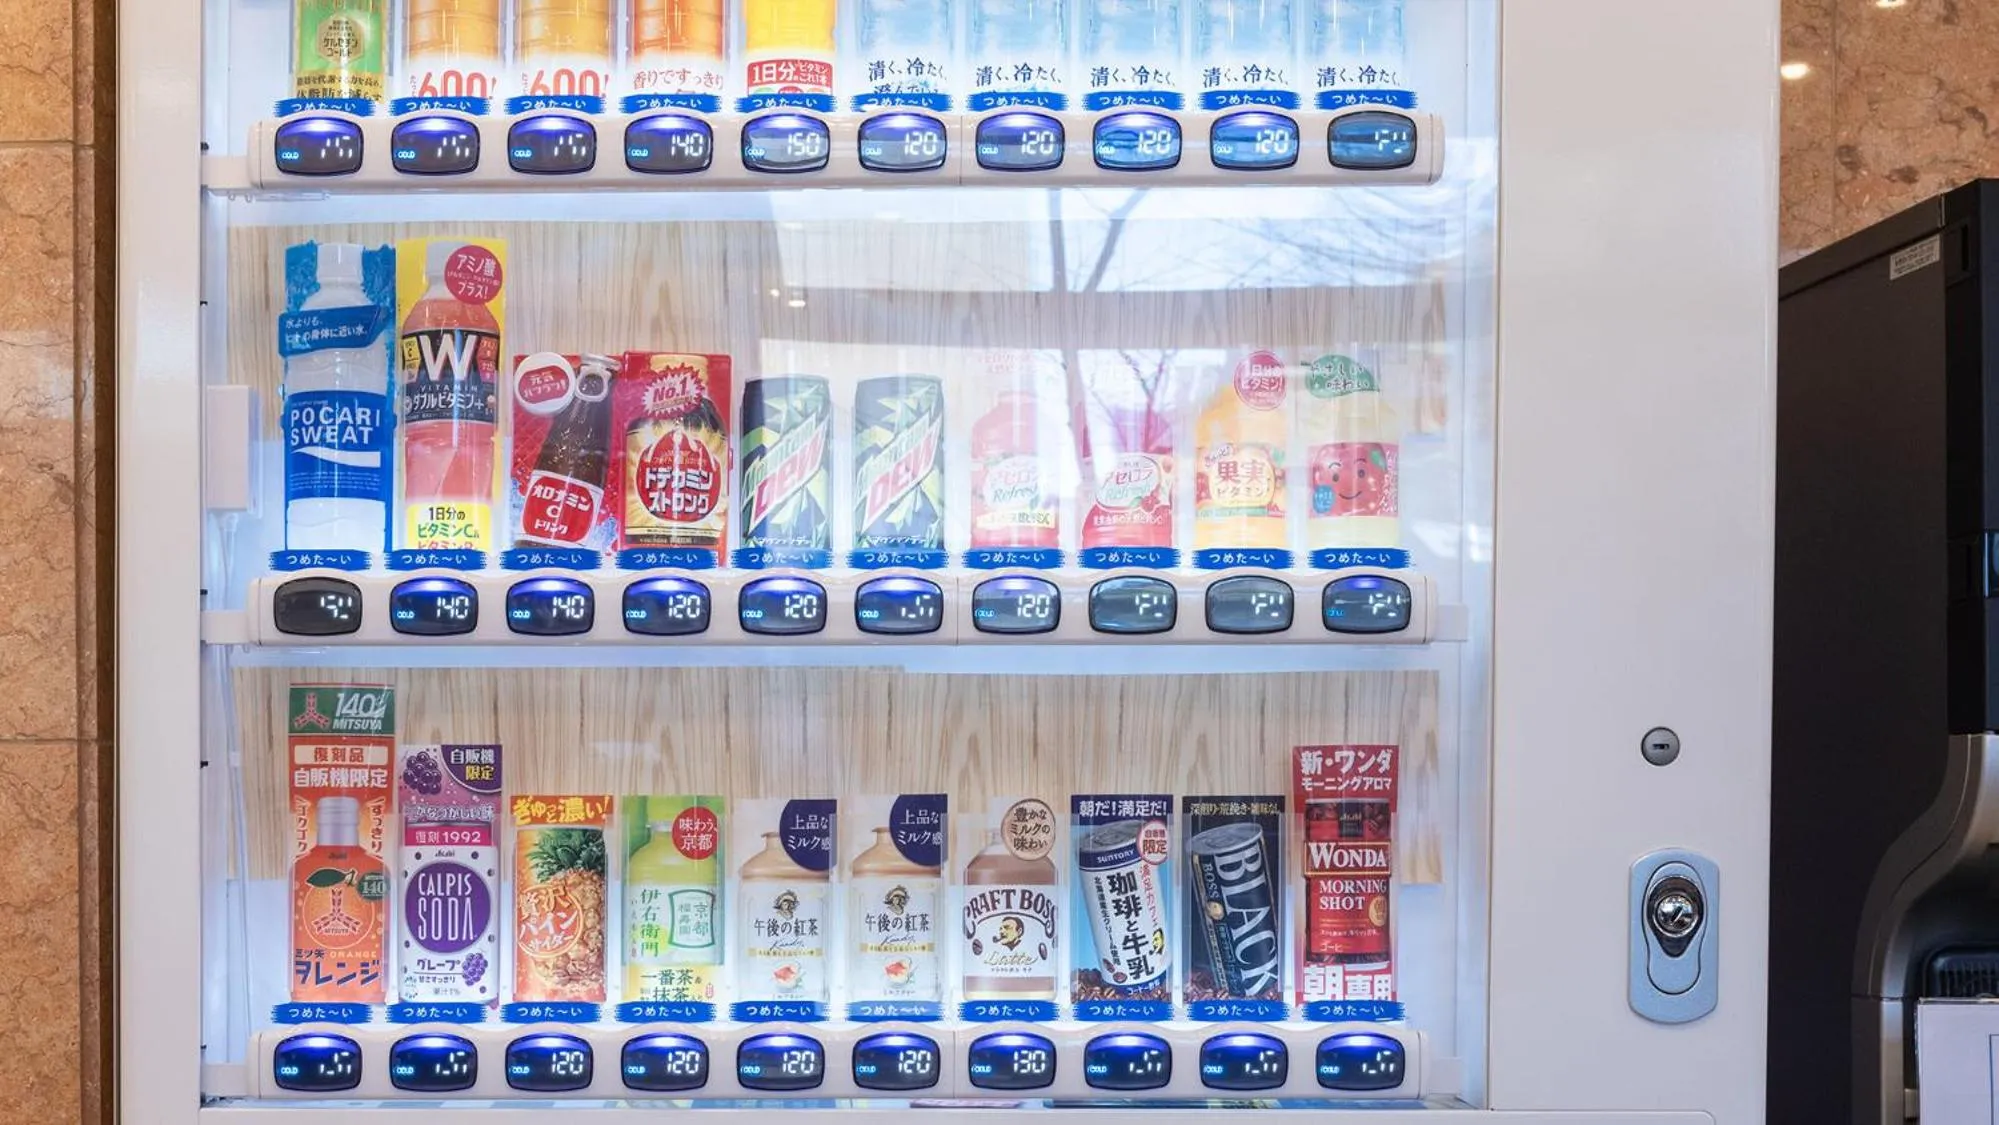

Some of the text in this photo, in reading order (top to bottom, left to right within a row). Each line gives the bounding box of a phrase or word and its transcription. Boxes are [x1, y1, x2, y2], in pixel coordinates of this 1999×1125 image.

[633, 67, 723, 90] 香りですっきり
[671, 133, 703, 157] 140
[787, 132, 820, 156] 150
[904, 132, 937, 156] 120
[1021, 130, 1054, 155] 120
[1137, 130, 1171, 155] 120
[1255, 130, 1288, 154] 120
[457, 254, 496, 278] アミノ酸
[458, 280, 488, 300] プラス!
[418, 333, 478, 381] W
[652, 377, 687, 402] No.1
[291, 405, 381, 428] POCARI
[291, 426, 373, 446] SWEAT
[645, 467, 713, 492] ドデカミン
[1217, 459, 1266, 483] 果実
[532, 484, 591, 511] オロナミン
[429, 507, 466, 520] 1日分の
[534, 518, 568, 535] ドリンク
[397, 611, 414, 619] COLD
[436, 596, 469, 619] 140
[513, 611, 530, 619] COLD
[552, 596, 585, 619] 140
[668, 595, 700, 618] 120
[784, 595, 816, 618] 120
[1017, 594, 1050, 618] 120
[332, 719, 382, 730] MITSUYA
[314, 747, 364, 763] 復刻品
[450, 748, 494, 765] 自販機
[1300, 748, 1393, 775] 新・ワンダ
[294, 767, 388, 789] 自販機限定
[465, 765, 494, 781] 限定
[1301, 775, 1392, 791] モーニングアロマ
[513, 796, 610, 826] ぎゅっと濃い!
[900, 809, 939, 825] 上品な
[1014, 807, 1047, 822] 豊かな
[1079, 800, 1167, 817] 朝だ!満足だ!
[296, 803, 308, 852] ゴクゴク
[371, 803, 383, 852] すっきり
[790, 814, 828, 830] 上品な
[1009, 822, 1051, 836] ミルクの
[442, 831, 481, 843] 1992
[681, 833, 713, 851] 京都
[787, 834, 831, 850] ミルク感
[897, 830, 942, 846] ミルク感
[1013, 836, 1048, 851] 味わい
[1142, 839, 1168, 854] 限定
[1308, 842, 1387, 869] WONDA
[418, 872, 473, 896] CALPIS
[1202, 863, 1221, 900] BOSS
[1319, 879, 1387, 894] MORNING
[963, 888, 1056, 940] CRAFT BOSS
[1319, 895, 1365, 911] SHOT
[418, 897, 474, 941] SODA
[519, 908, 578, 941] パイン
[639, 889, 662, 957] 伊右衛門
[754, 917, 819, 937] 午後の紅茶
[865, 912, 929, 932] 午後の紅茶
[1106, 871, 1155, 980] 珈琲と牛乳
[1213, 842, 1279, 997] BLACK
[528, 932, 574, 951] サイダー
[329, 950, 377, 959] ORANGE
[416, 957, 461, 971] グレープ
[280, 1066, 298, 1075] COLD
[396, 1066, 414, 1075] COLD
[512, 1066, 529, 1075] COLD
[551, 1051, 584, 1075] 120
[627, 1066, 646, 1074] COLD
[666, 1051, 699, 1074] 120
[781, 1051, 815, 1074] 120
[898, 1050, 931, 1074] 120
[1014, 1050, 1046, 1073] 130
